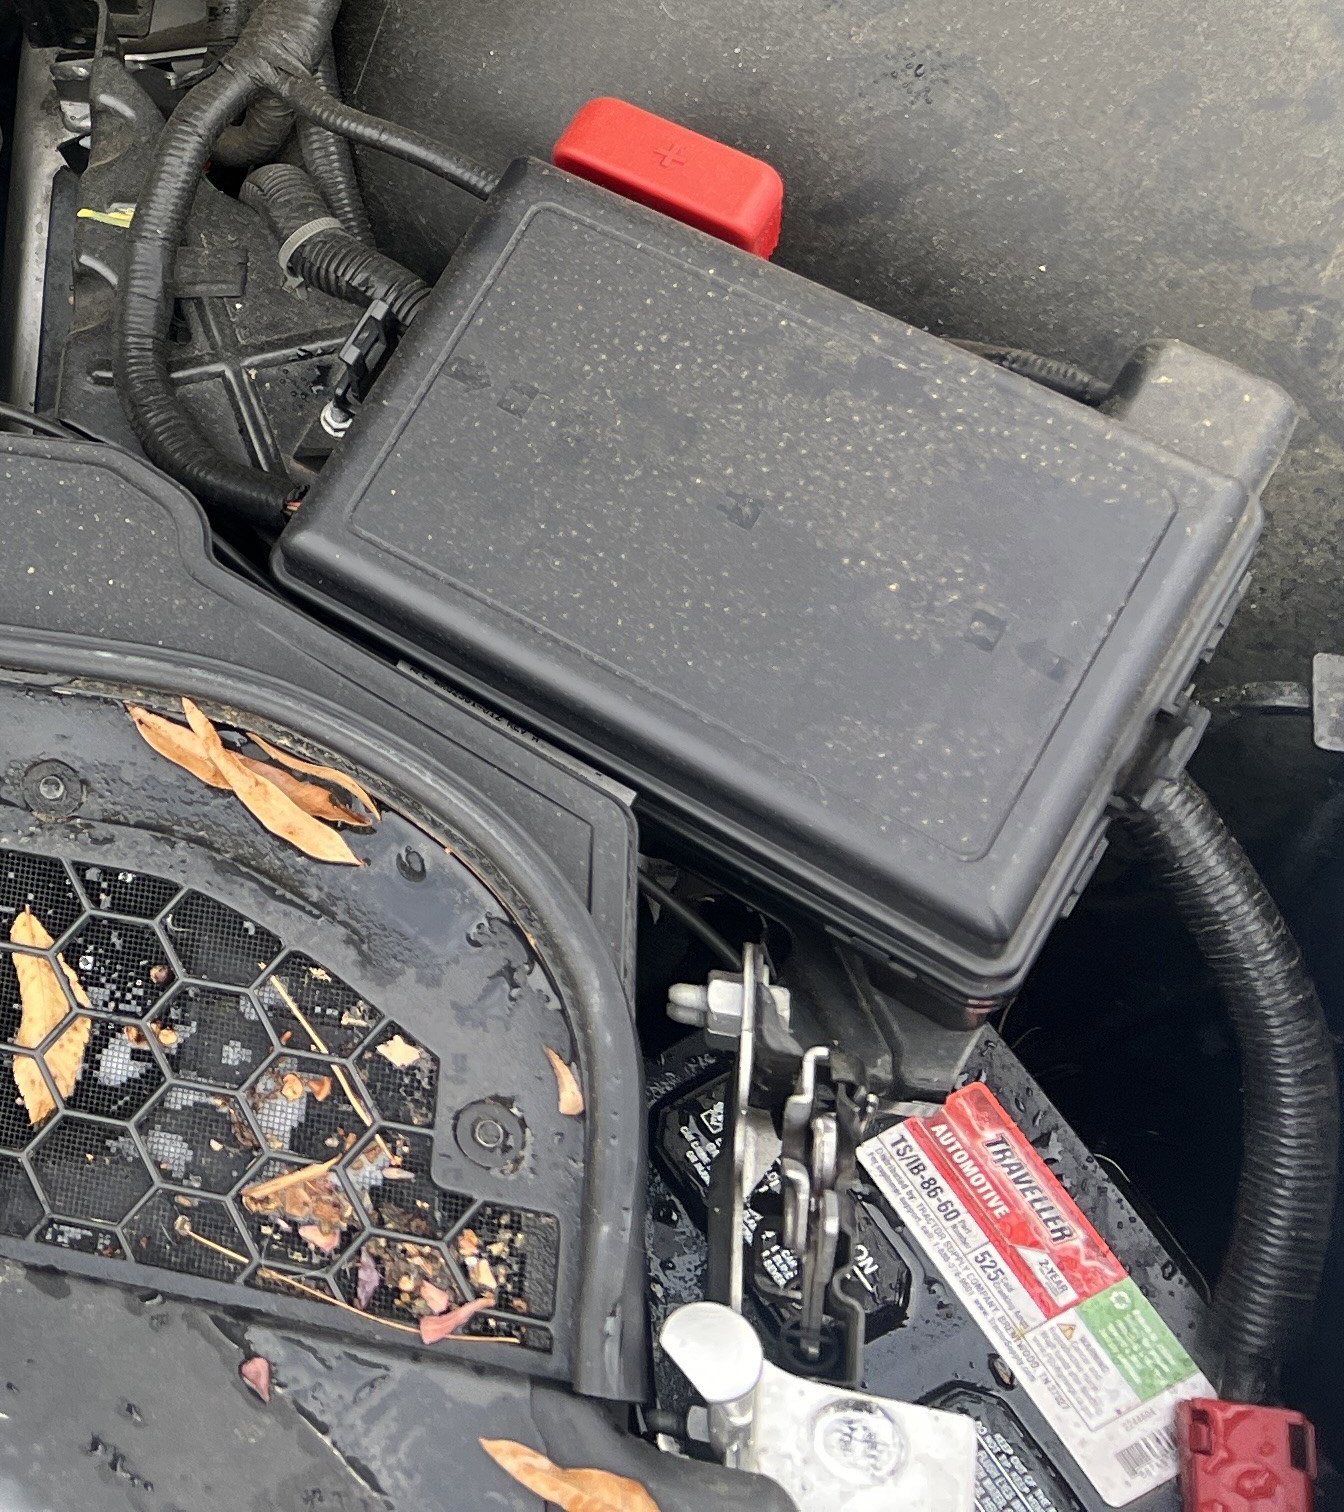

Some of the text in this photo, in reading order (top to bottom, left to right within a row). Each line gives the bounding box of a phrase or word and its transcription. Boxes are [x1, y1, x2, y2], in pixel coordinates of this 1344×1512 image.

[888, 1133, 961, 1222] TS/IB-86-60
[930, 1121, 1011, 1219] AUTOMOTIVE
[984, 1133, 1075, 1244] TRAVELLER
[913, 1201, 947, 1241] TRACTOR
[941, 1238, 971, 1273] SUPPLY
[972, 1247, 1006, 1284] 525
[1037, 1256, 1070, 1295] 2-YEAR
